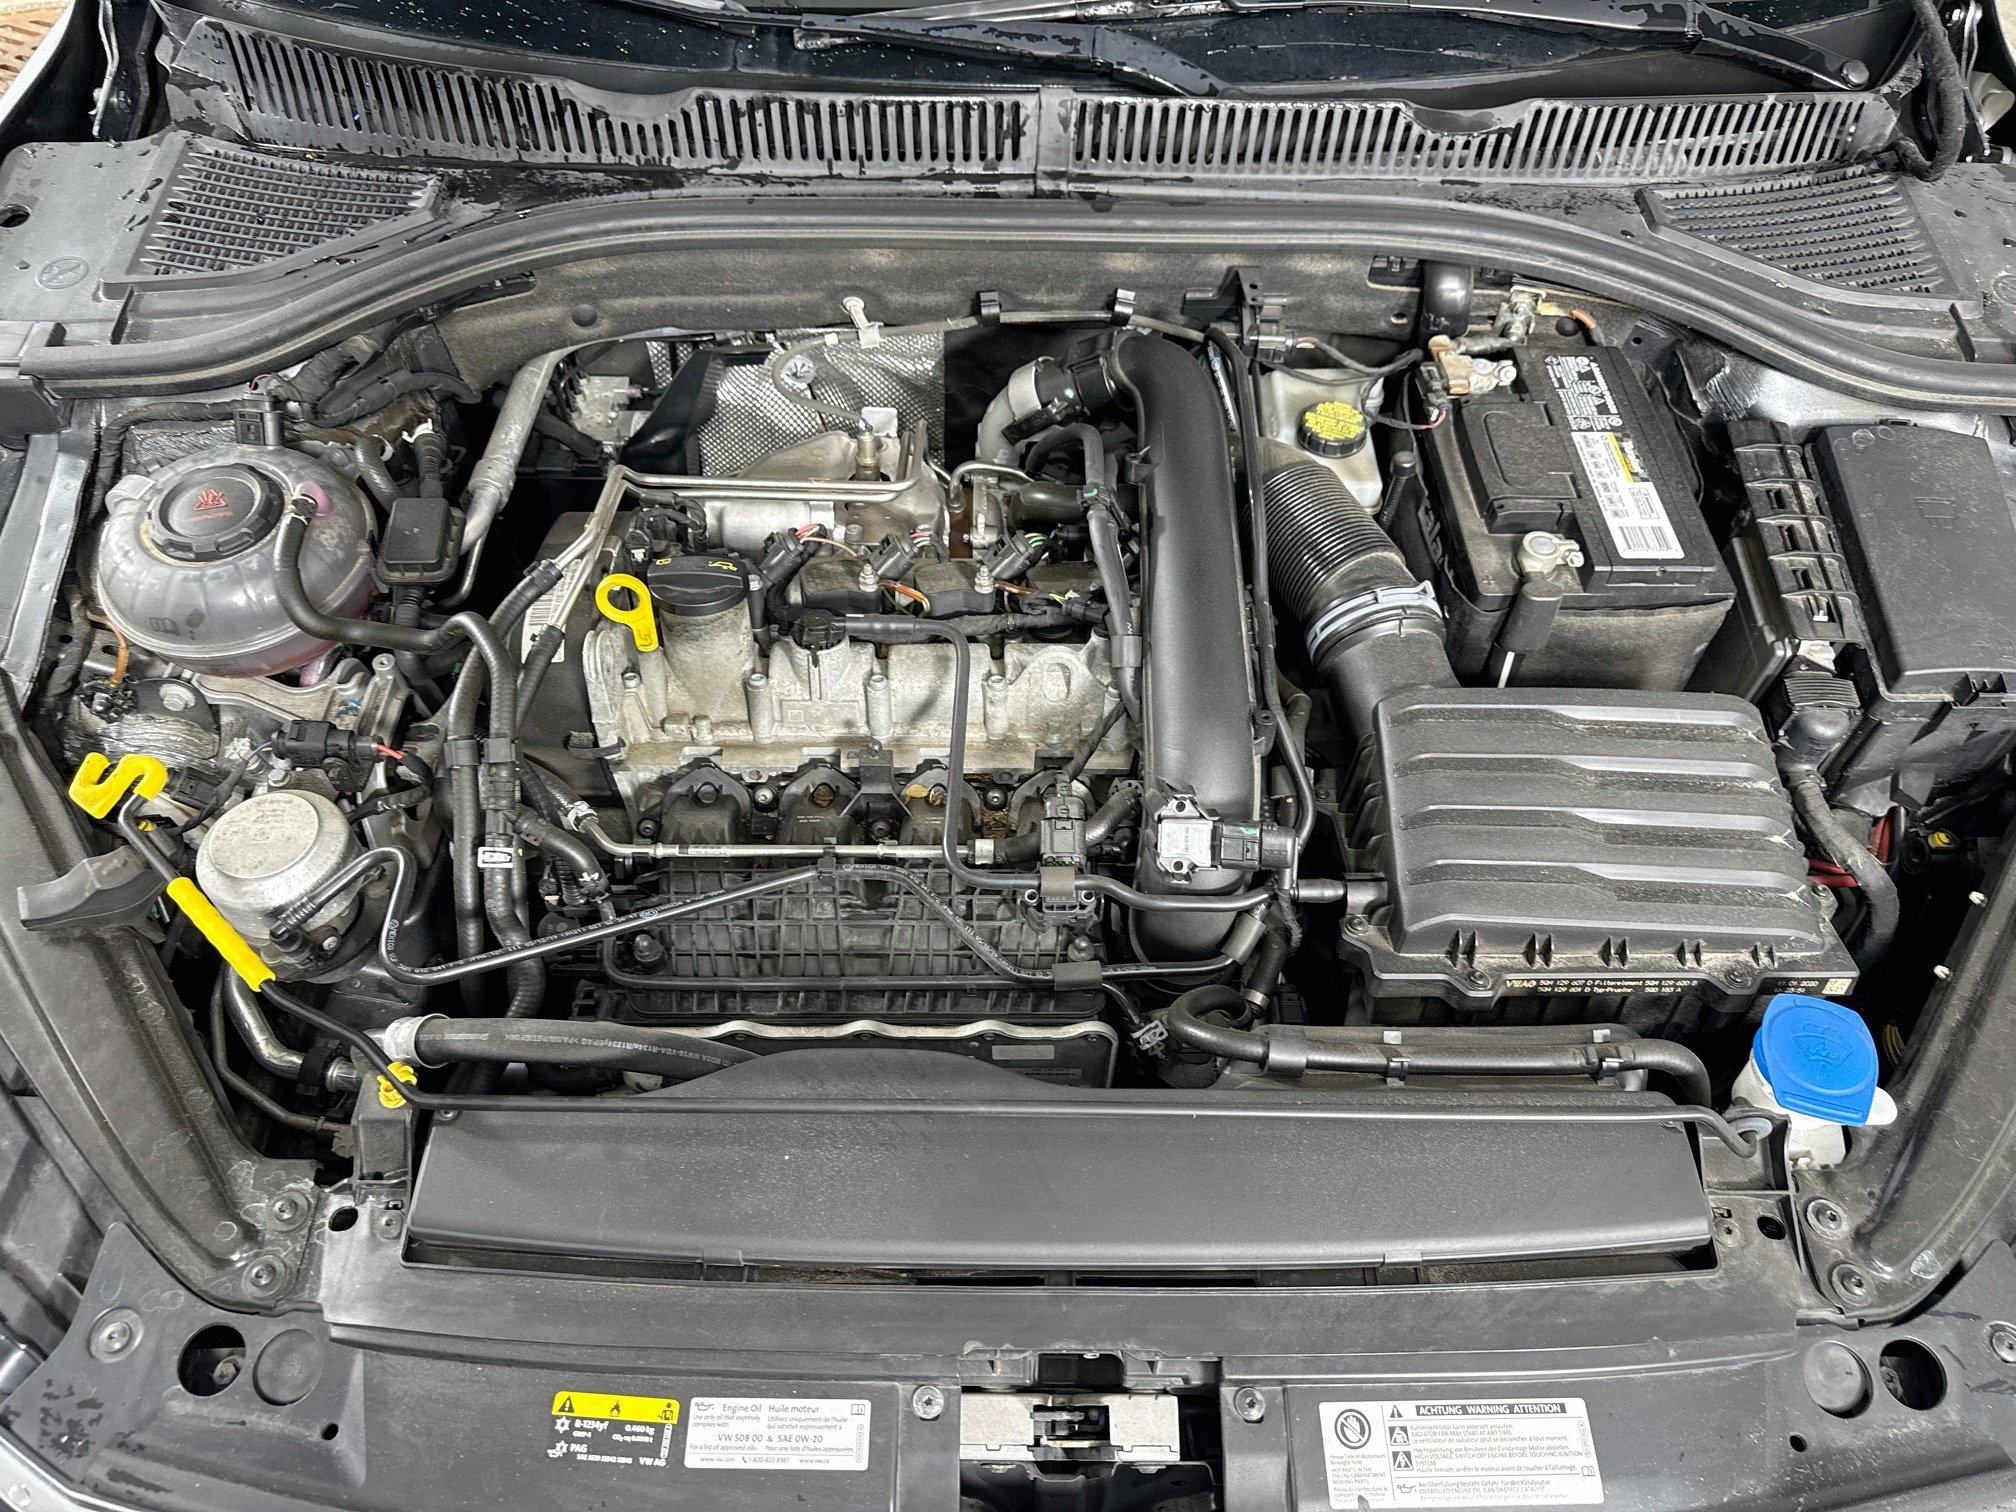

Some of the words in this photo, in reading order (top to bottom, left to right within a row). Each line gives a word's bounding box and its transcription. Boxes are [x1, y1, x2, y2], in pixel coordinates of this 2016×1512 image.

[722, 1403, 749, 1414] Engine
[750, 1403, 762, 1412] Oil
[768, 1404, 789, 1413] Huile
[790, 1405, 820, 1413] moteur
[1419, 1405, 1463, 1415] ACHTUNG
[1466, 1404, 1510, 1415] WARNING
[1513, 1403, 1562, 1414] ATTENTION
[704, 1414, 715, 1422] only
[574, 1419, 609, 1432] R-1234yf
[692, 1421, 716, 1429] complies
[766, 1423, 776, 1431] qui
[645, 1425, 655, 1436] kg
[1463, 1429, 1478, 1437] START
[718, 1433, 733, 1442] VW
[734, 1433, 750, 1442] 508
[751, 1434, 763, 1442] 00
[777, 1434, 793, 1443] SAE
[794, 1435, 823, 1443] 0W-20
[569, 1443, 588, 1453] PAG
[720, 1444, 746, 1452] approved
[639, 1457, 653, 1465] VW
[653, 1458, 667, 1467] AG
